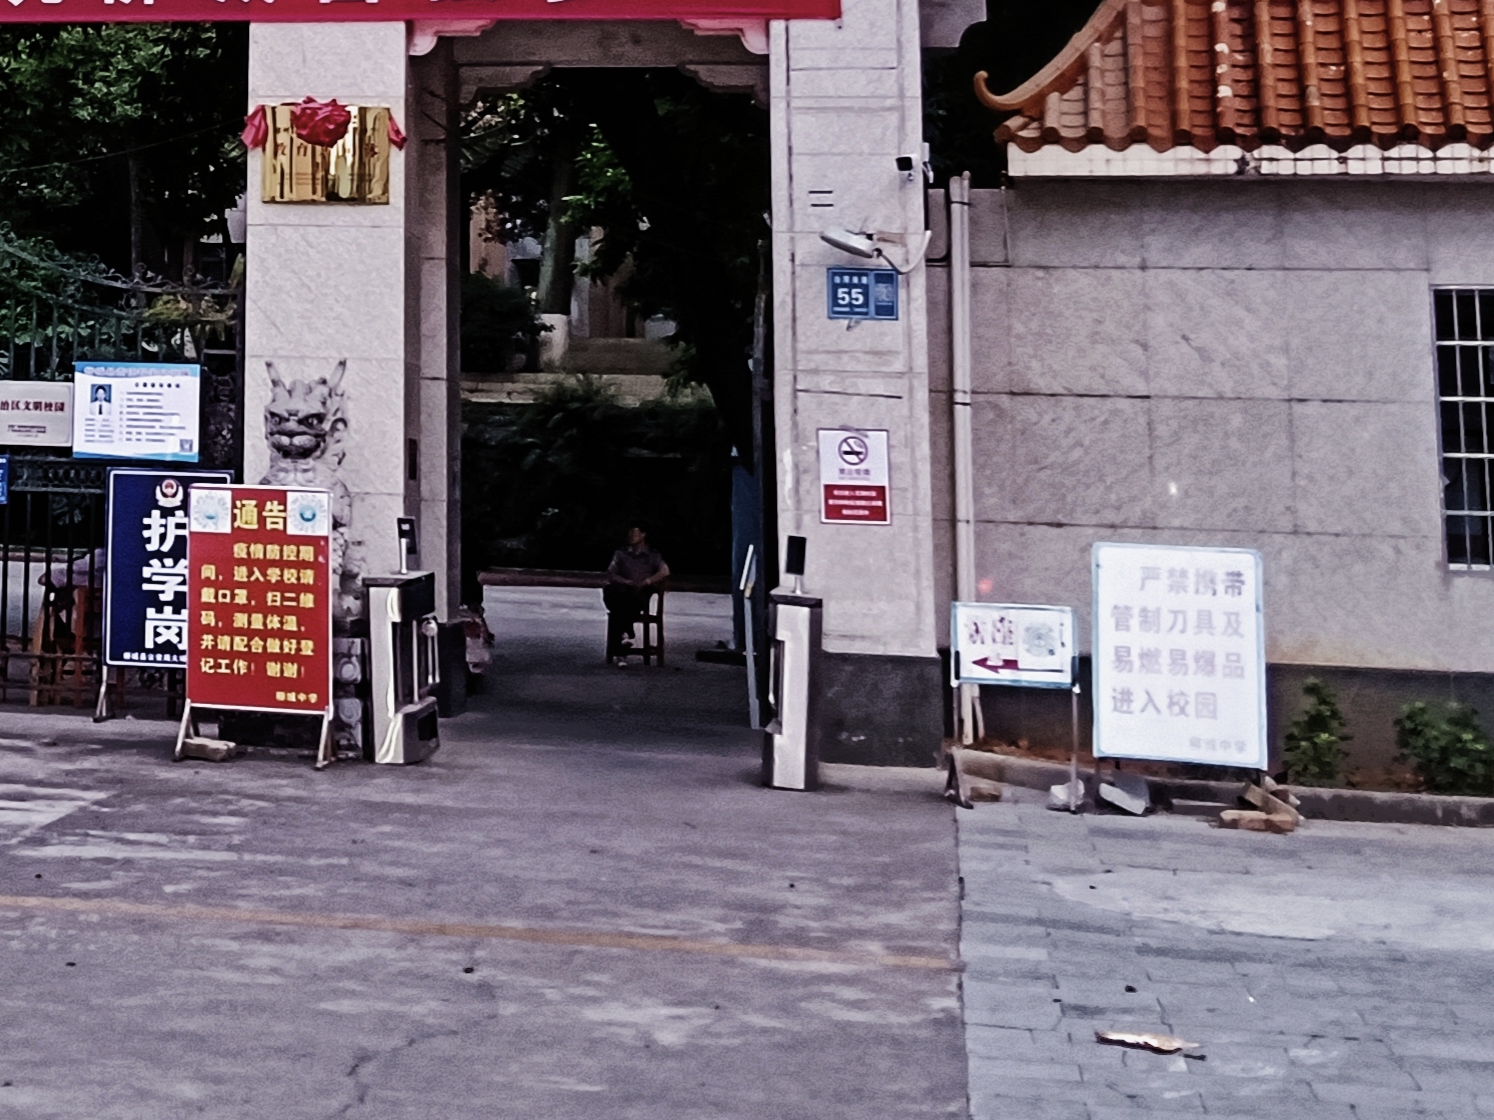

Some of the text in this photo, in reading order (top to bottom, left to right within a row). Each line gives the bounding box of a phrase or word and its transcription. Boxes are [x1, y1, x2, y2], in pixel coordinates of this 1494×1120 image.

[837, 287, 864, 305] 55
[233, 499, 287, 530] 通告
[233, 542, 315, 562] 疫情防控期
[142, 509, 188, 651] 护学岗
[1139, 566, 1246, 597] 严禁携带
[1110, 604, 1245, 639] 管制刀具及
[200, 634, 315, 656] 并请配合做好登
[1112, 645, 1245, 680] 易燃易爆品
[1111, 686, 1218, 721] 进入校园
